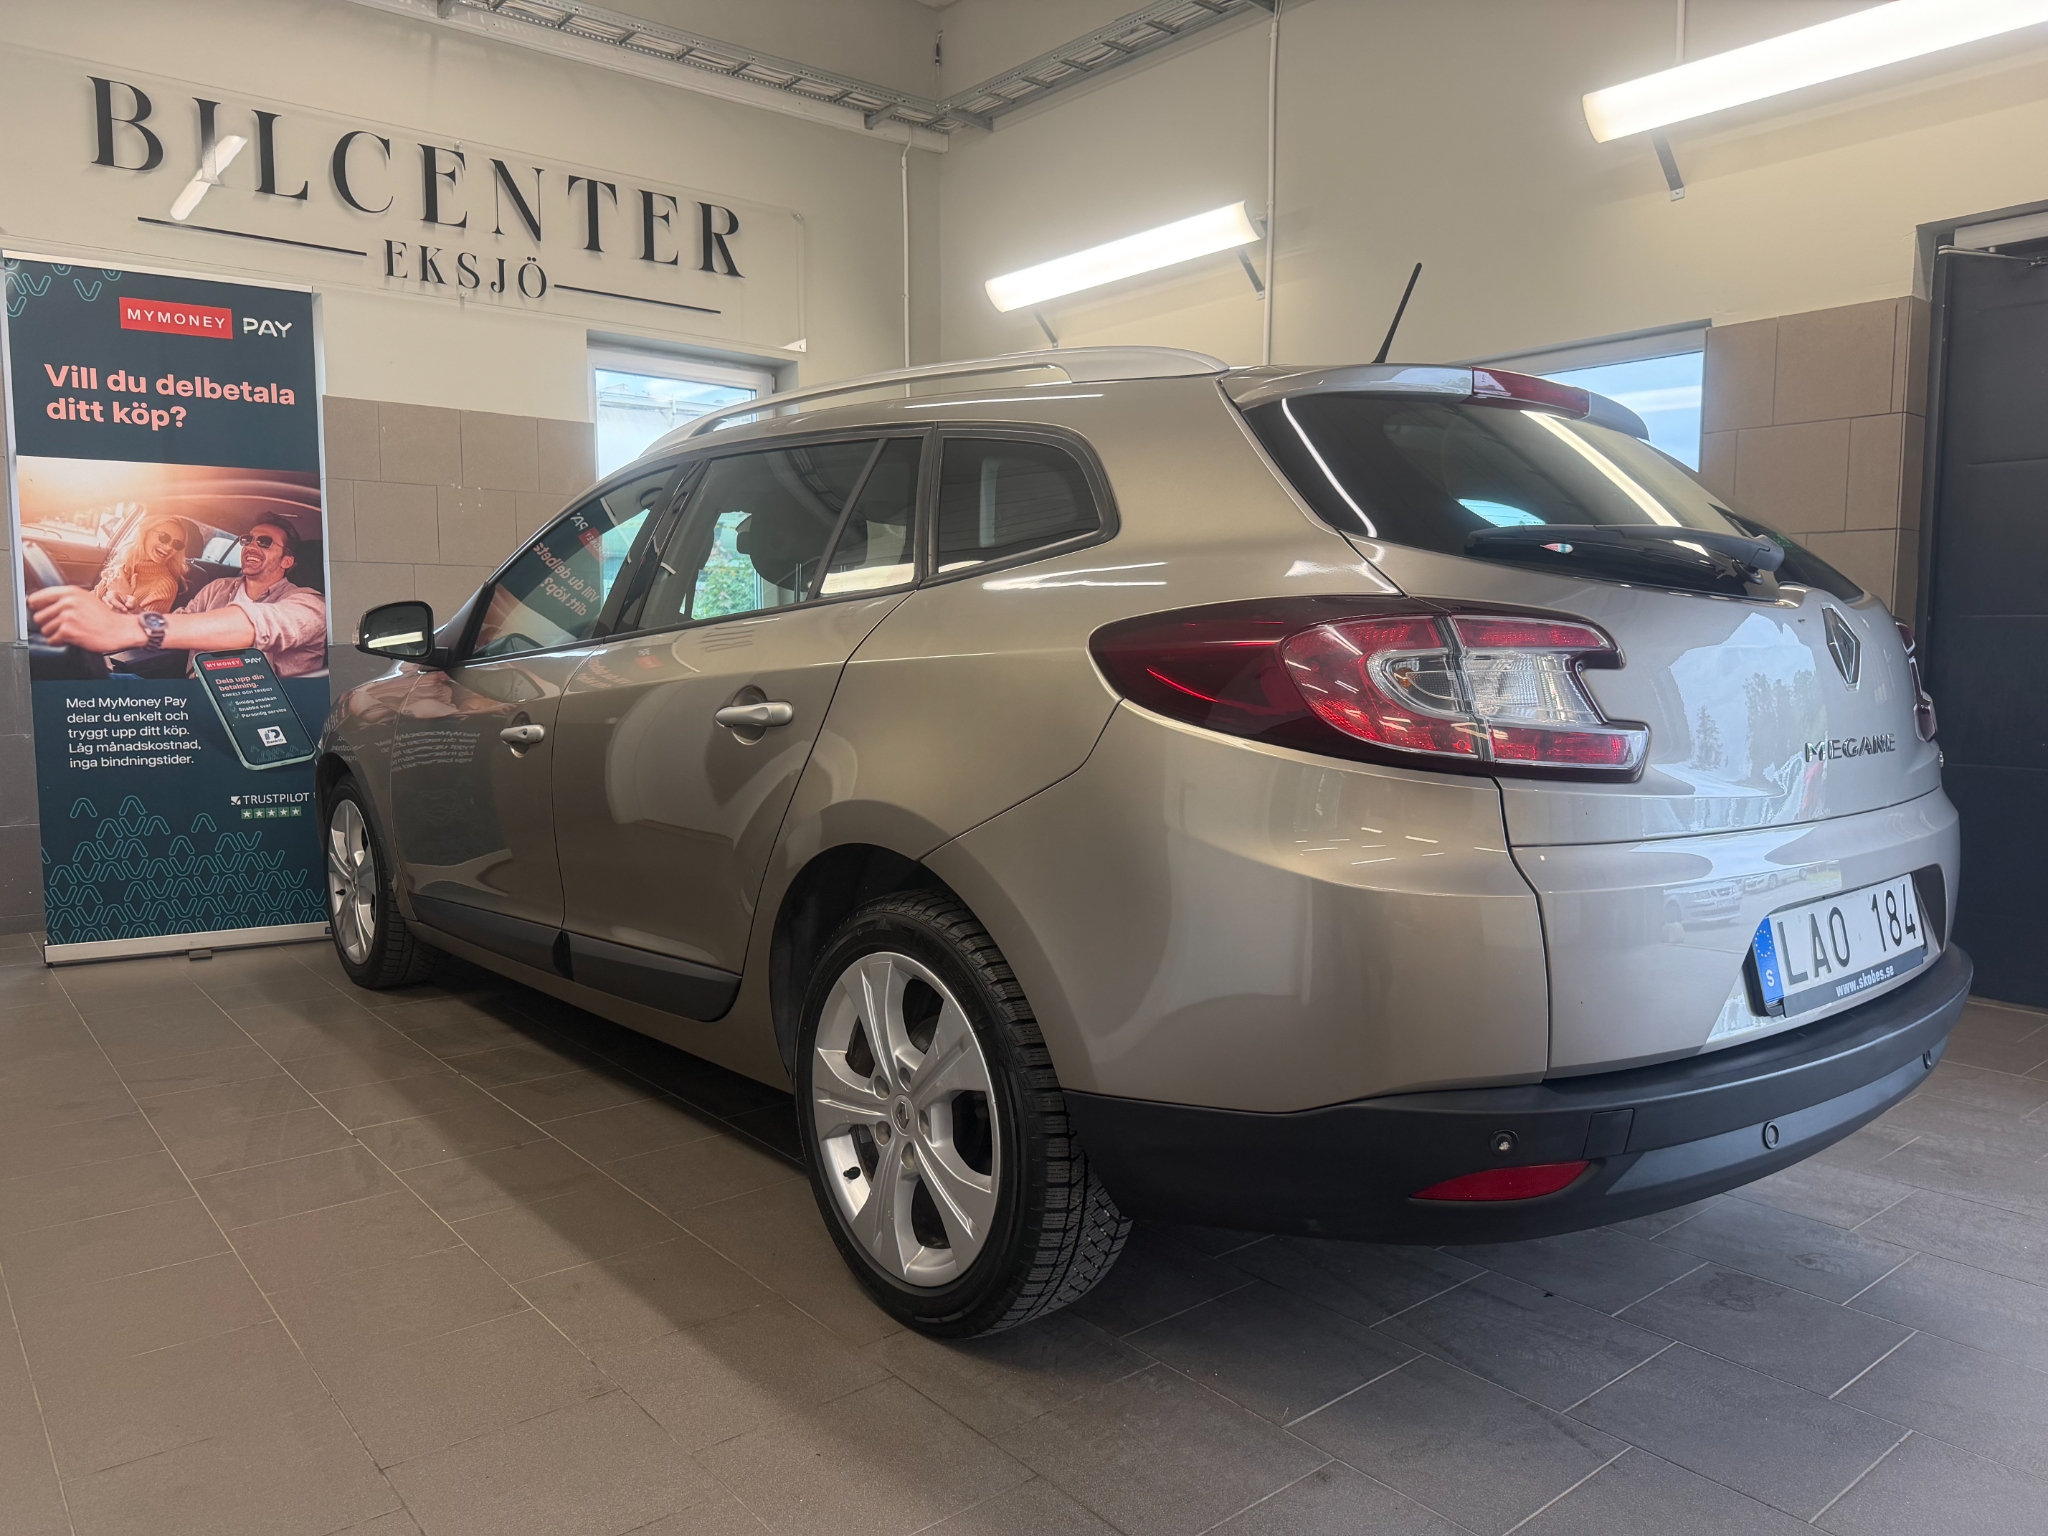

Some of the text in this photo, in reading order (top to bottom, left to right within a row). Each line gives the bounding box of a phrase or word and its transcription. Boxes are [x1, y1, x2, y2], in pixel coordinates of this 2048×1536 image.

[86, 75, 746, 279] BILCENTER
[384, 239, 548, 299] EKSJÖ
[127, 308, 292, 338] MYMONEY PAY
[44, 363, 295, 405] Vill du delbetala
[46, 398, 187, 431] ditt köp?
[66, 696, 187, 709] Med MyMoney Pay
[67, 711, 189, 723] delar du enkelt och
[68, 725, 190, 740] tryggt upp ditt köp.
[69, 740, 201, 755] Låg månadskostnad,
[70, 755, 194, 770] inga bindningstider.
[1804, 733, 1896, 763] MEGANE
[243, 792, 309, 805] TRUSTPILOT
[1777, 883, 1916, 986] LAO 184
[1766, 970, 1775, 987] S
[1836, 965, 1895, 997] www.skobes.se
